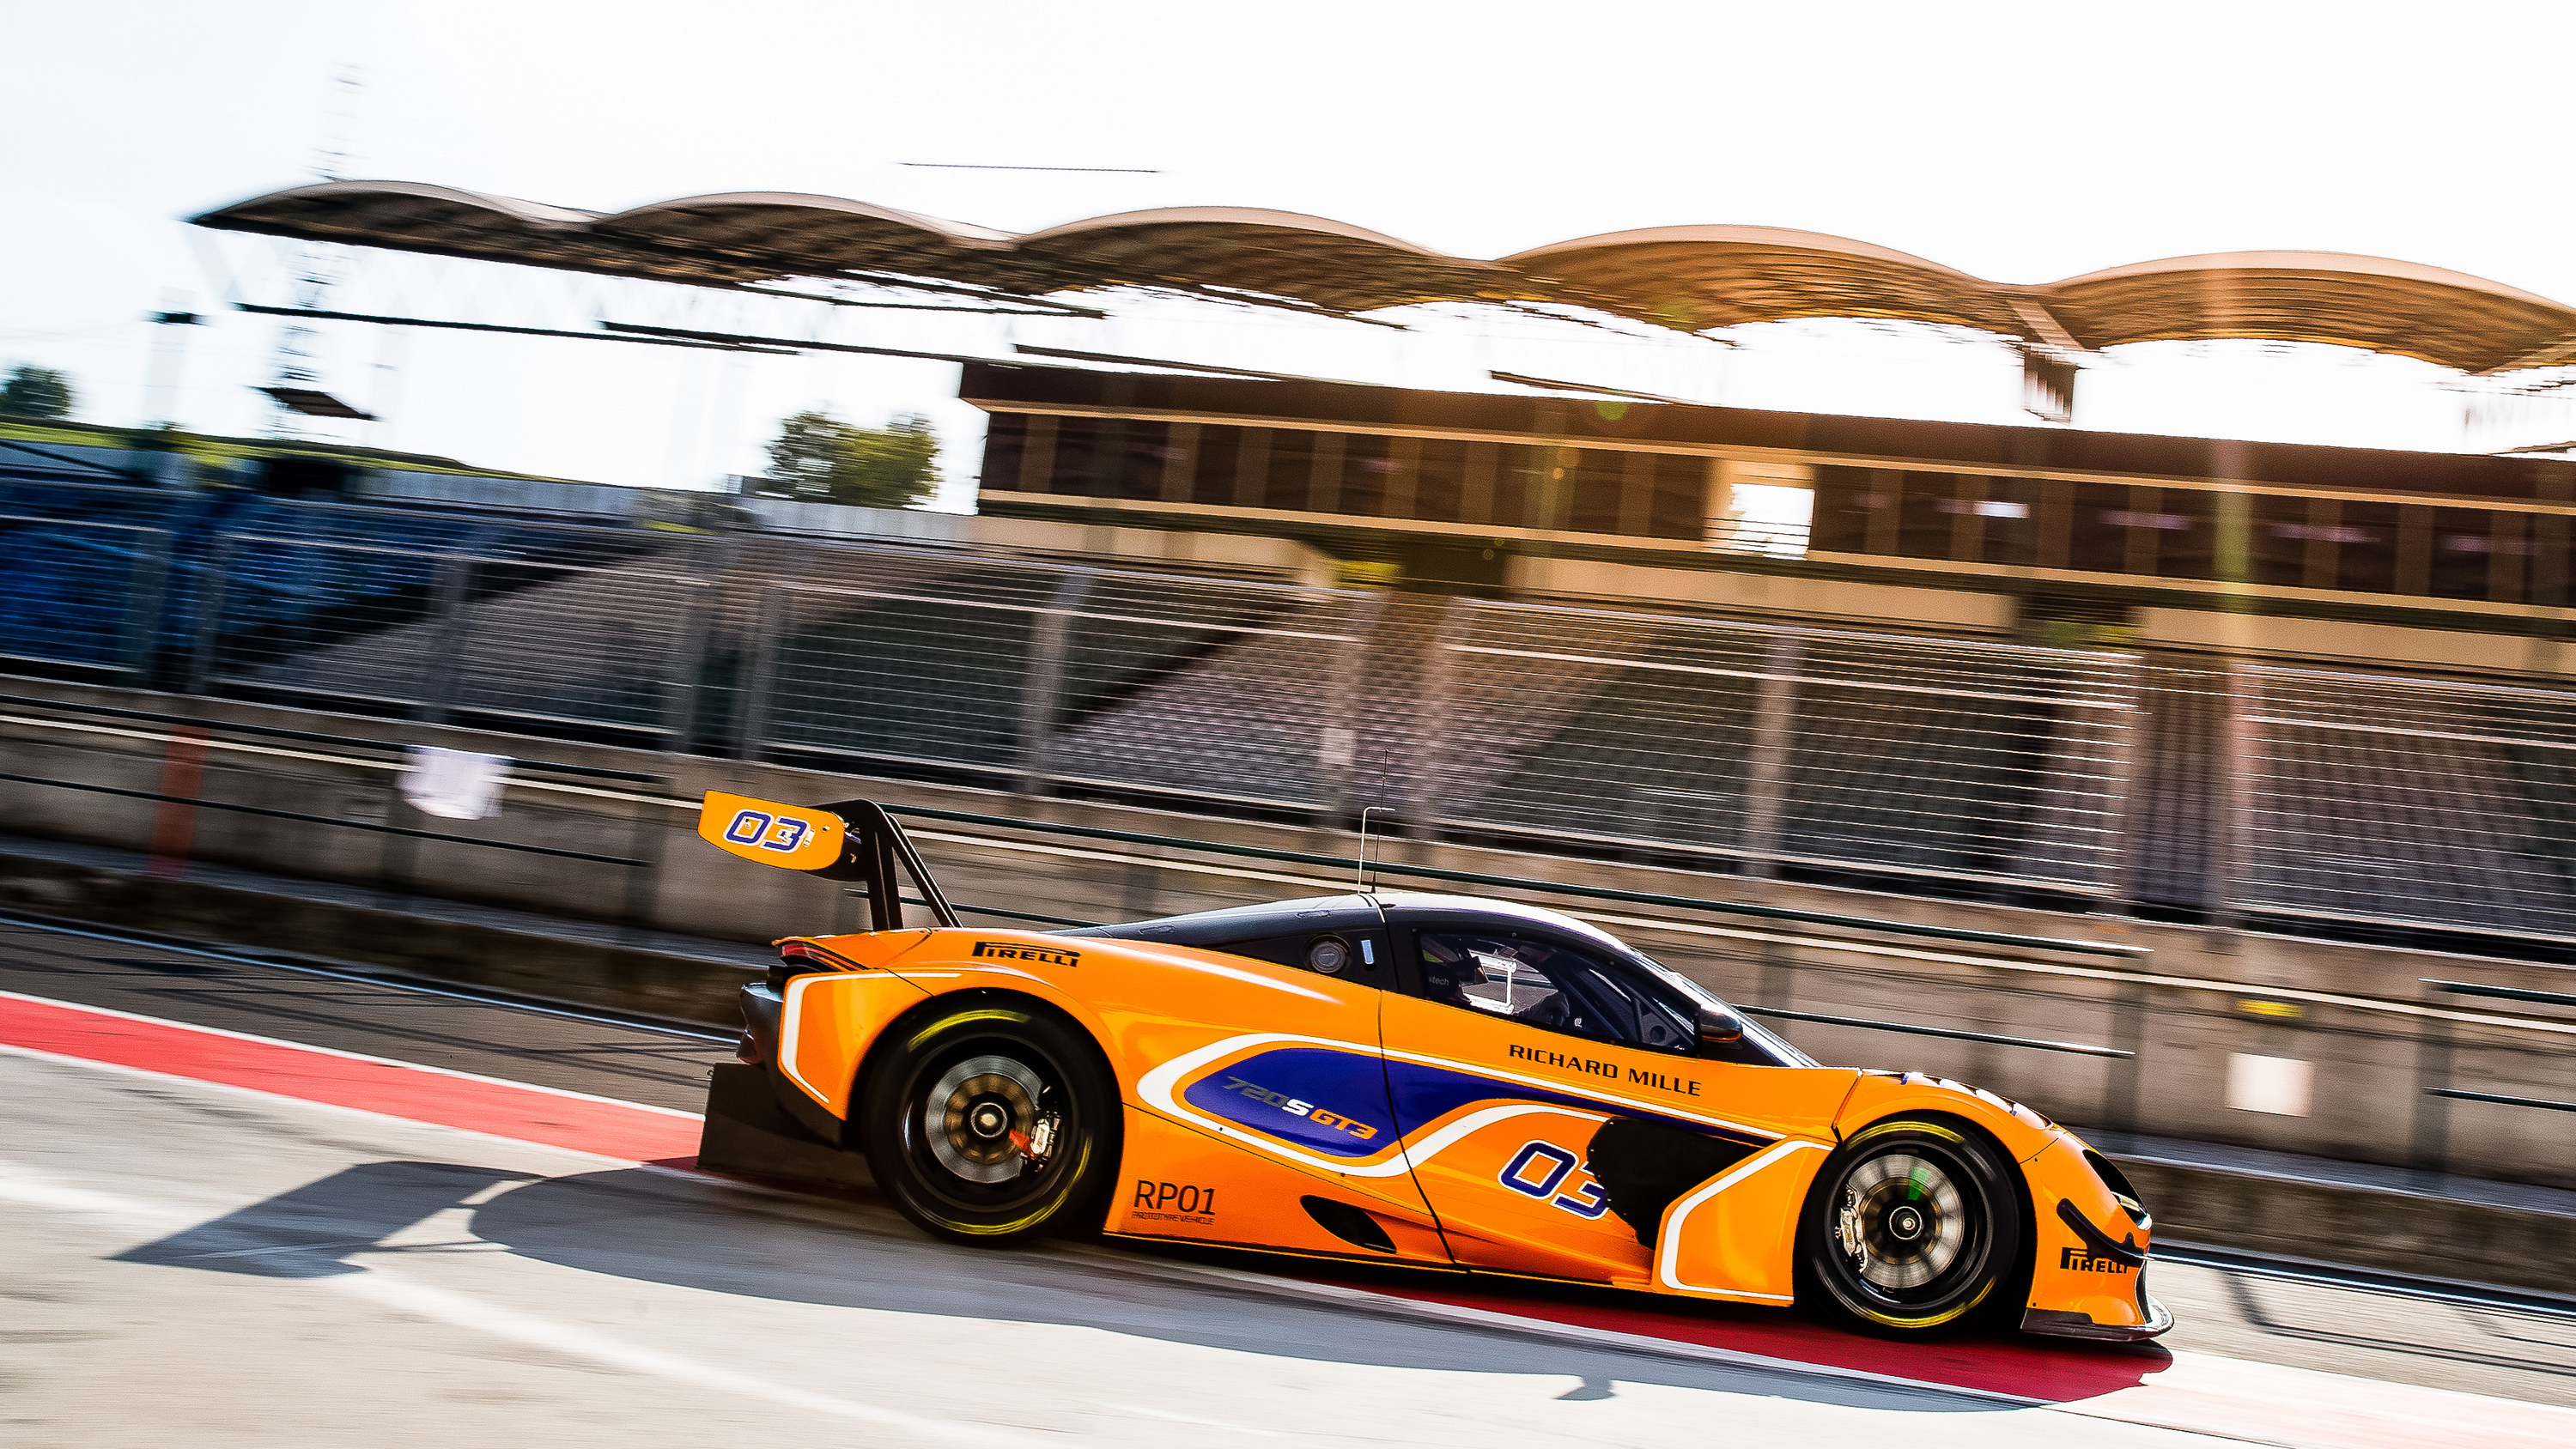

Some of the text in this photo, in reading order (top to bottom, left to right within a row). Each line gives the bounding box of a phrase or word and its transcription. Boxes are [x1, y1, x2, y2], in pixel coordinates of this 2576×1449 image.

[723, 809, 811, 853] 03
[972, 942, 1081, 967] PIRELLI
[1509, 1044, 1702, 1097] RICHARD MILLE
[1133, 1179, 1216, 1216] RP01
[2060, 1246, 2128, 1274] PIRELLI
